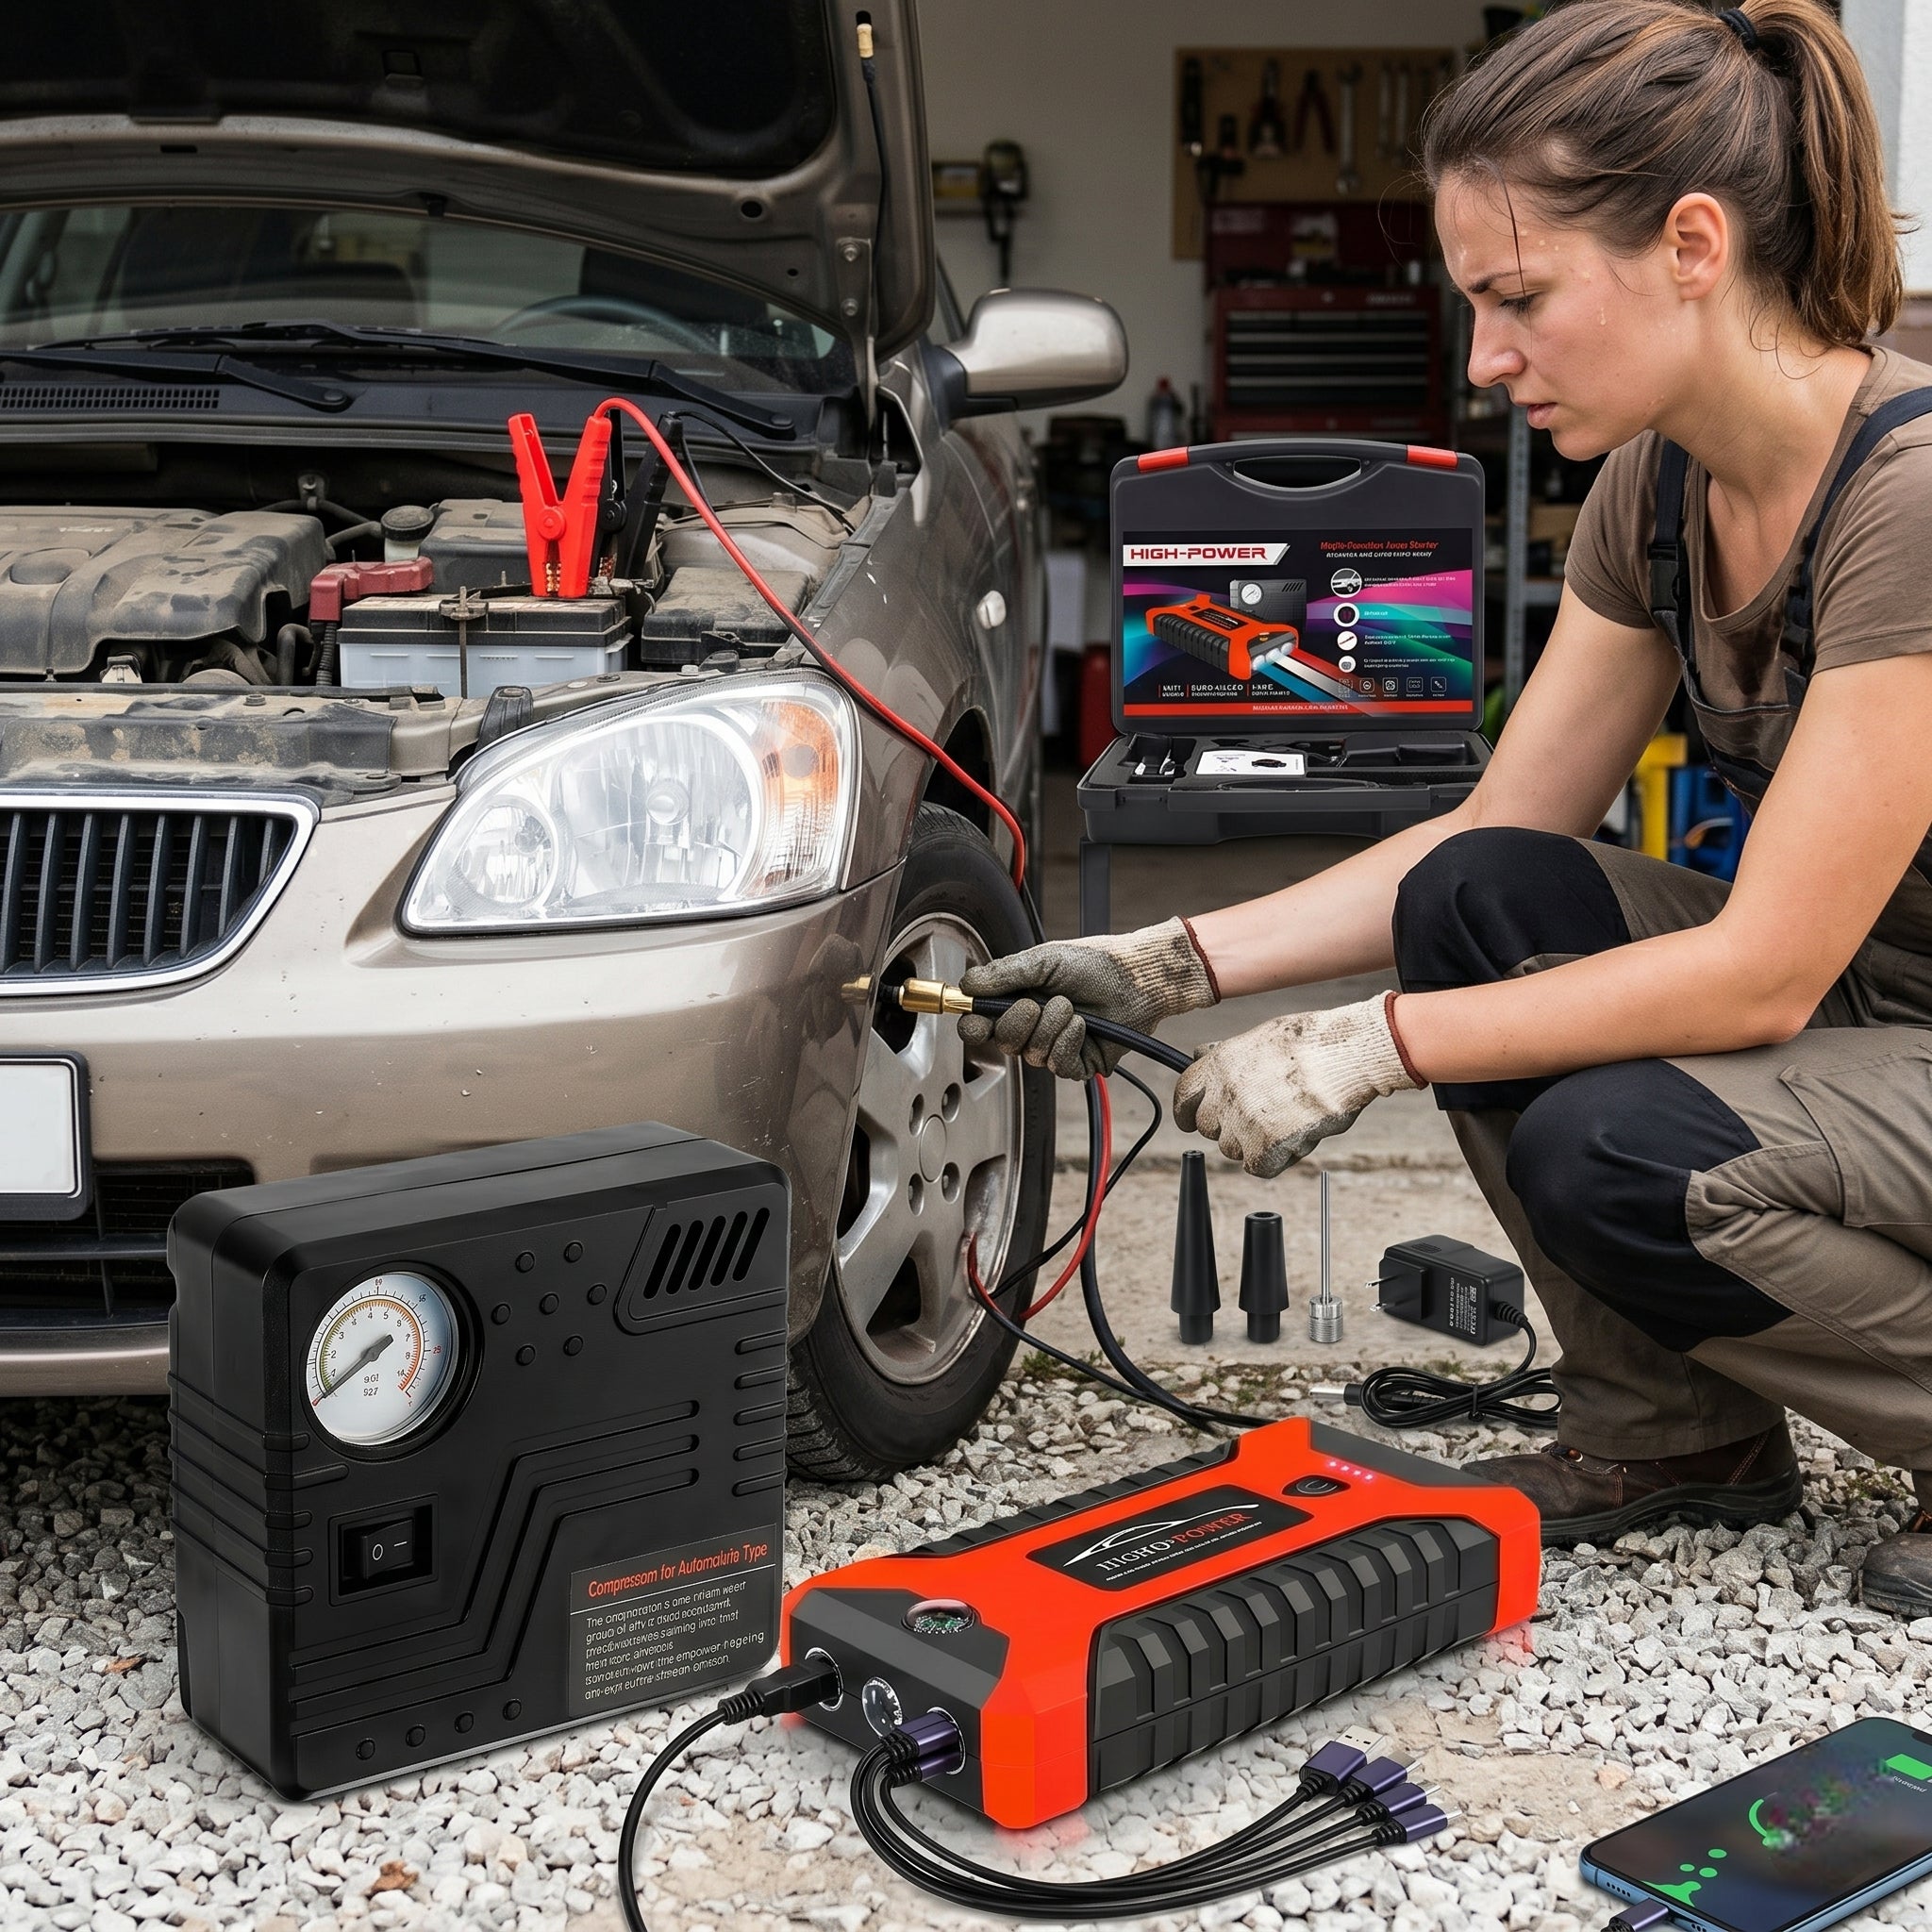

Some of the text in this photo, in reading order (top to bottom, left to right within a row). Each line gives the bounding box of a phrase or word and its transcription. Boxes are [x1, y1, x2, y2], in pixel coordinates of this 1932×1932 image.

[1130, 547, 1268, 560] HIGH-POWER
[660, 1564, 676, 1580] for
[742, 1544, 768, 1563] Type
